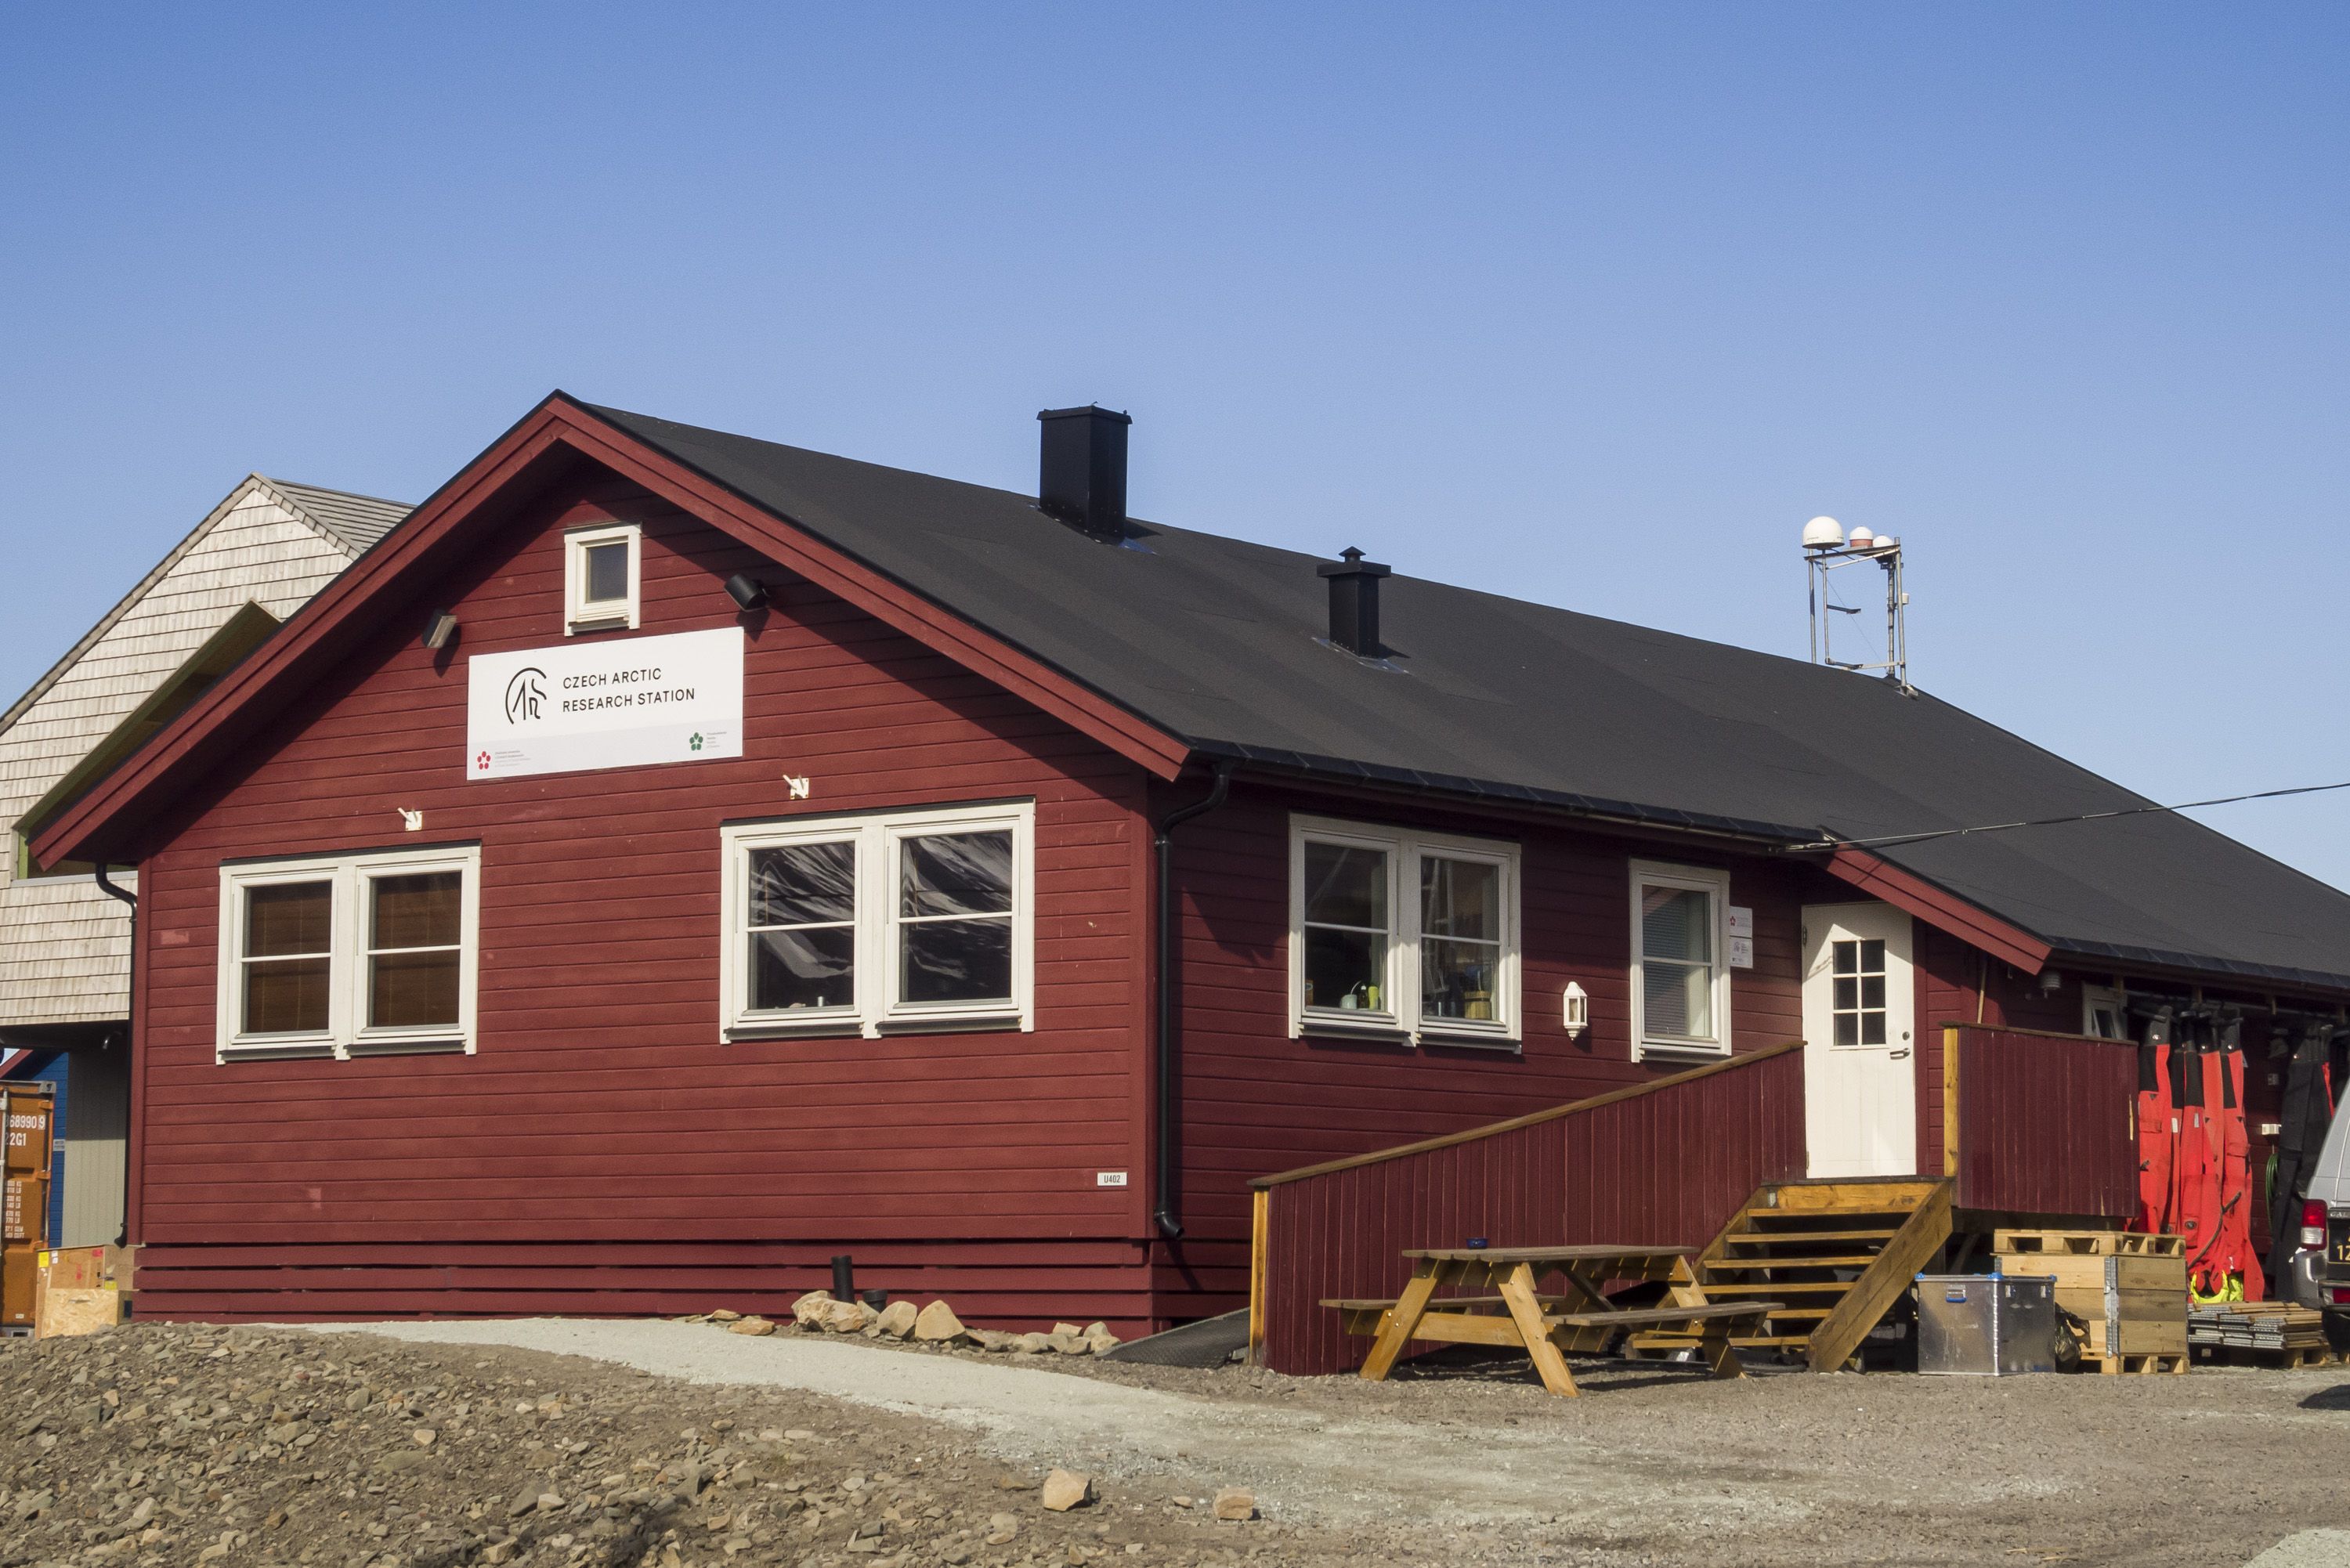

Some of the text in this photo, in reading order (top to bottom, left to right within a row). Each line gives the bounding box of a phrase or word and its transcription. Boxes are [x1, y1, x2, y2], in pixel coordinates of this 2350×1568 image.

[563, 667, 662, 689] CZECH ARCTIC
[562, 688, 695, 713] RESEARCH STATION
[1104, 1175, 1121, 1183] U402
